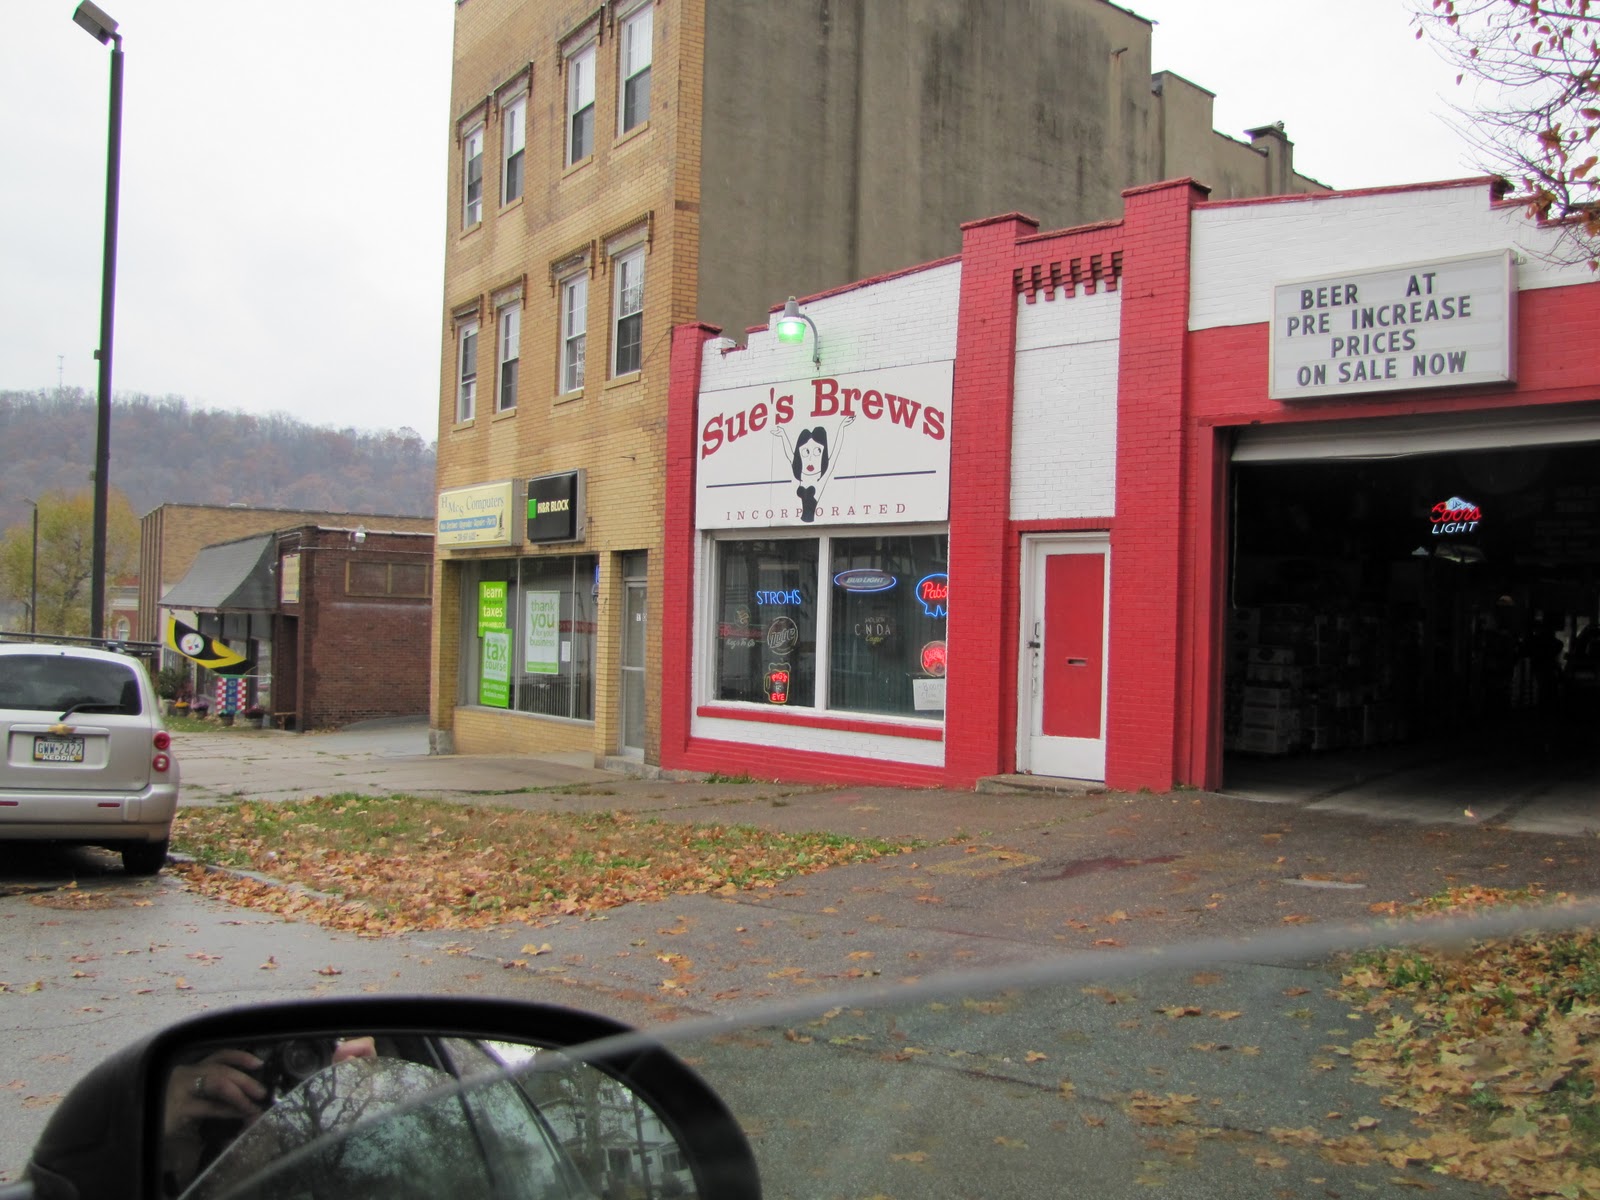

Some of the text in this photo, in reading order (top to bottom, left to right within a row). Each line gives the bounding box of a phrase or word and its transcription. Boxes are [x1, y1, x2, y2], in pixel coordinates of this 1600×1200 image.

[1300, 272, 1436, 310] BEER AT
[1287, 295, 1472, 337] PRE INCREASE
[1331, 328, 1416, 358] PRICES
[1297, 351, 1467, 386] ON SALE NOW
[701, 378, 946, 460] Sue's Brews
[466, 496, 505, 512] Computers
[537, 499, 570, 514] H&R BLOCK
[726, 503, 907, 521] INCORPORATED
[1429, 501, 1482, 523] Coors
[1431, 521, 1479, 534] LIGHT
[483, 584, 503, 598] learn
[922, 581, 948, 600] Pabs
[483, 605, 503, 617] taxes
[530, 599, 555, 612] thank
[530, 614, 555, 635] you
[486, 639, 507, 662] tax
[529, 636, 556, 646] business
[226, 680, 236, 711] OPEN
[771, 692, 785, 701] EYE
